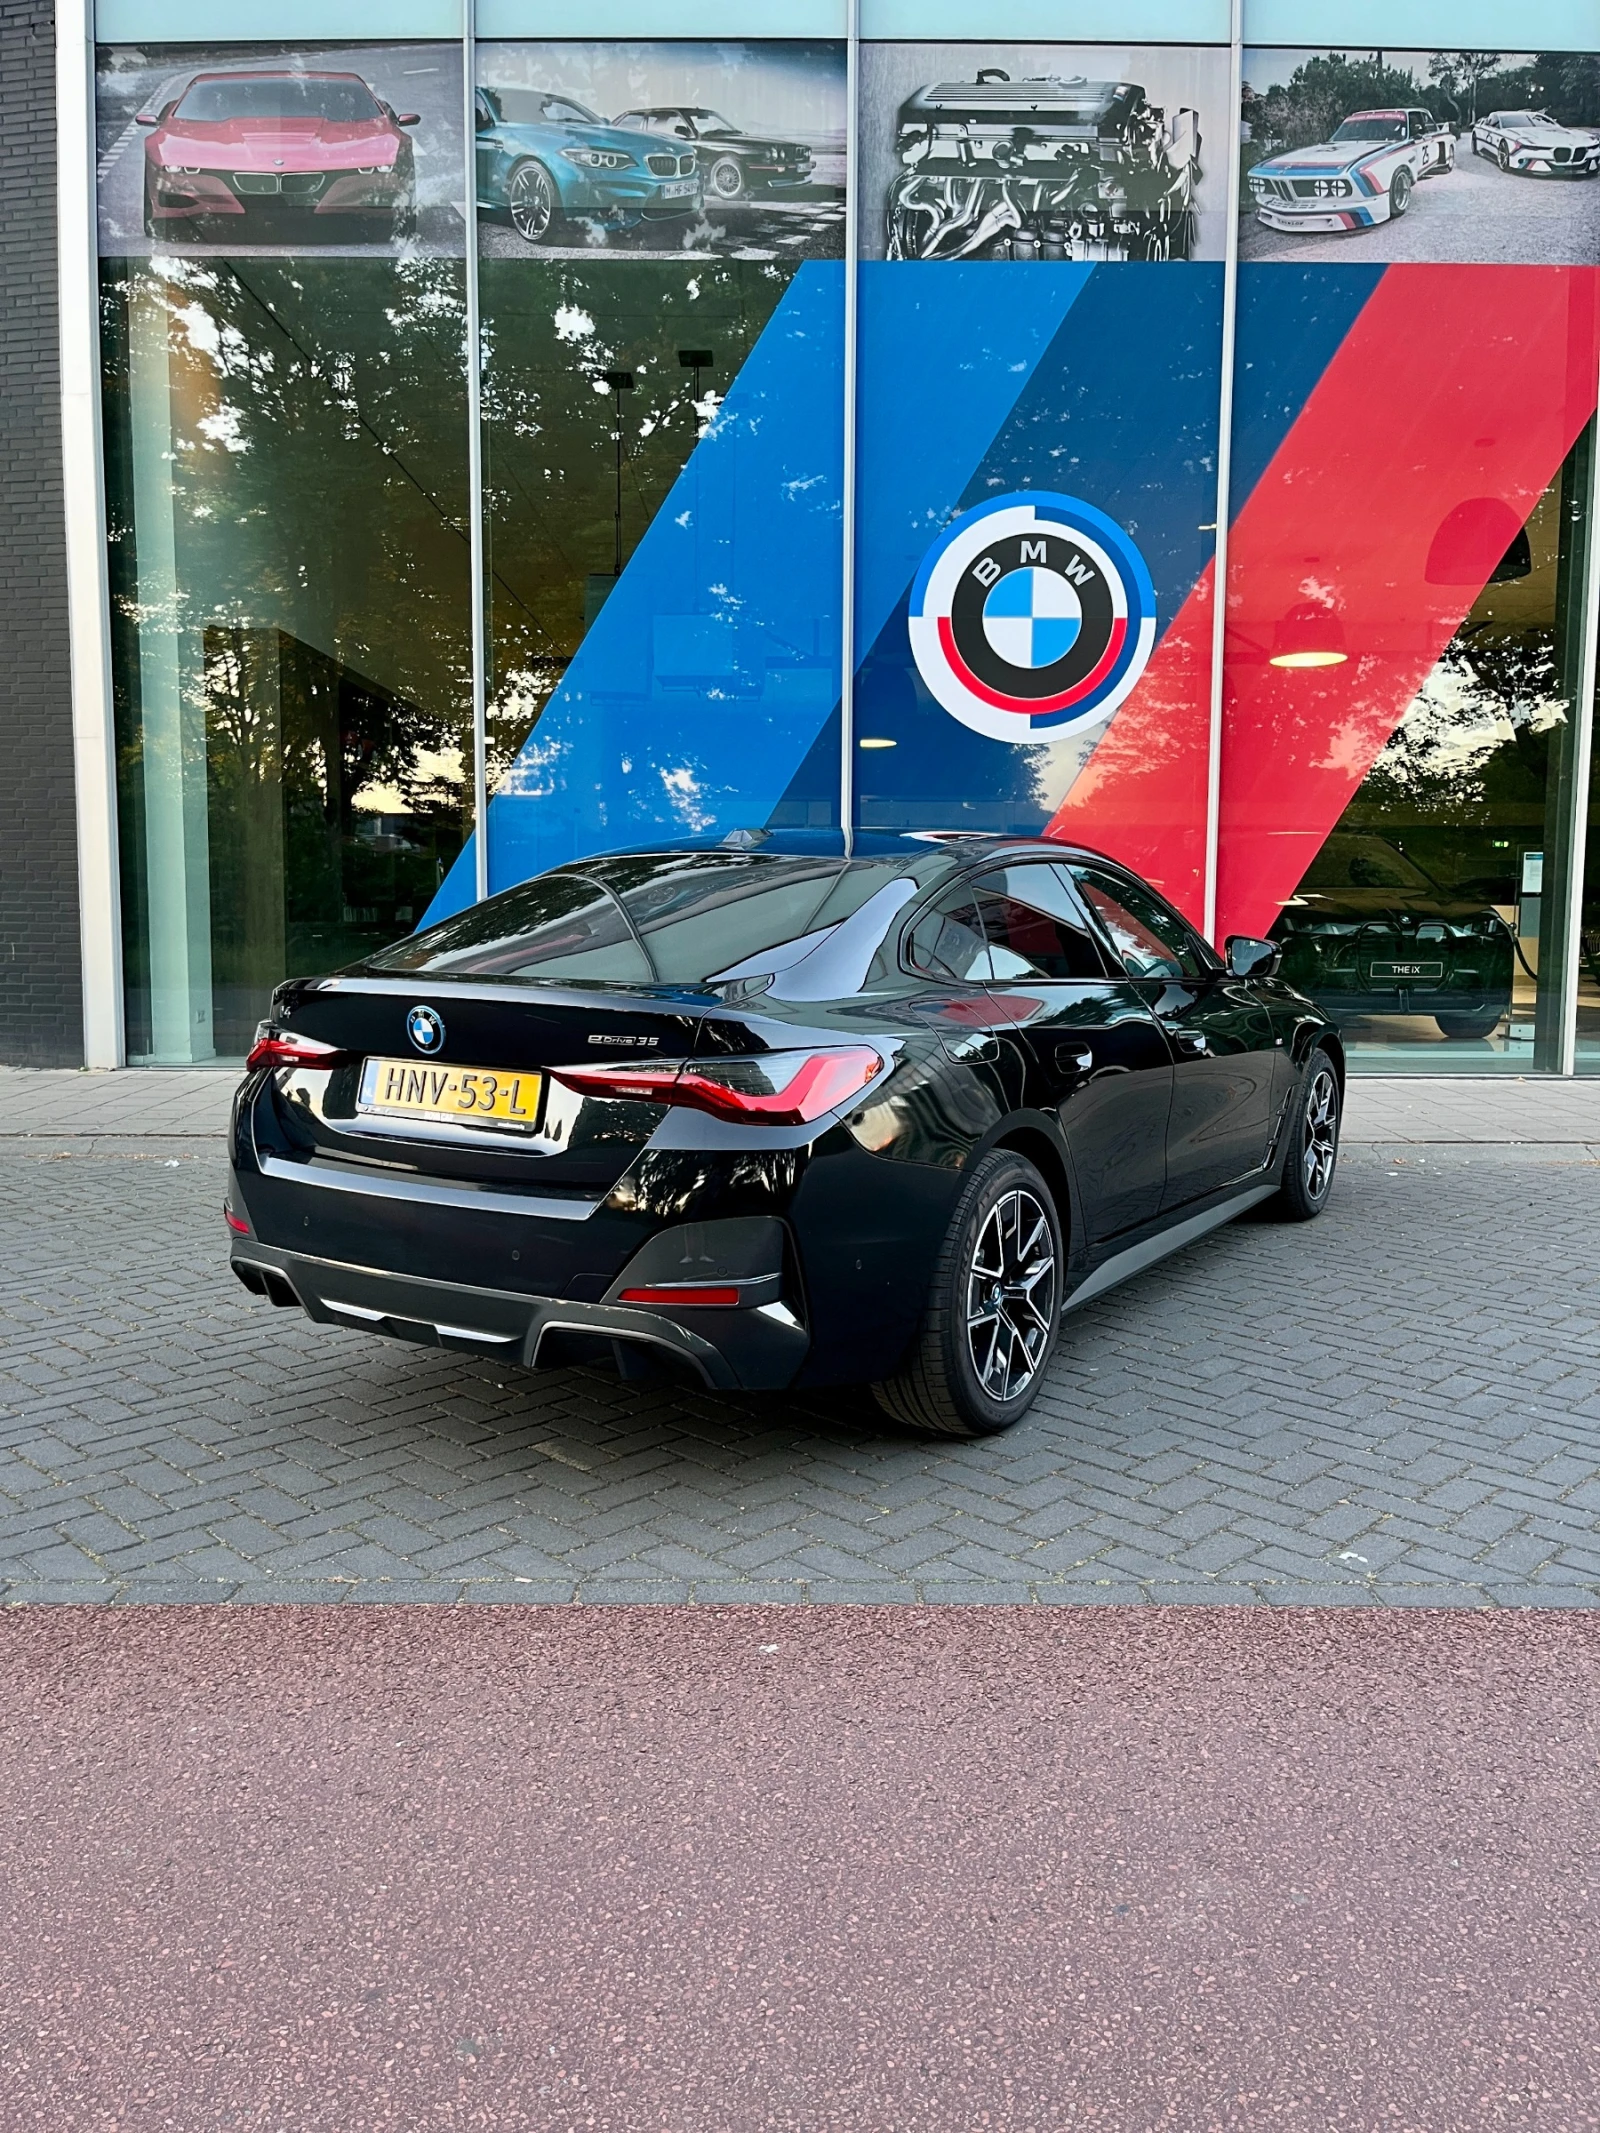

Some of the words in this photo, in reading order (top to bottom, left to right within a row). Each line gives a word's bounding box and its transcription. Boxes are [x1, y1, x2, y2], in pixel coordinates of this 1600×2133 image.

[1422, 145, 1430, 166] 25
[972, 541, 1096, 587] BMW
[1392, 965, 1410, 974] THE
[385, 1067, 527, 1114] HNV-53-L
